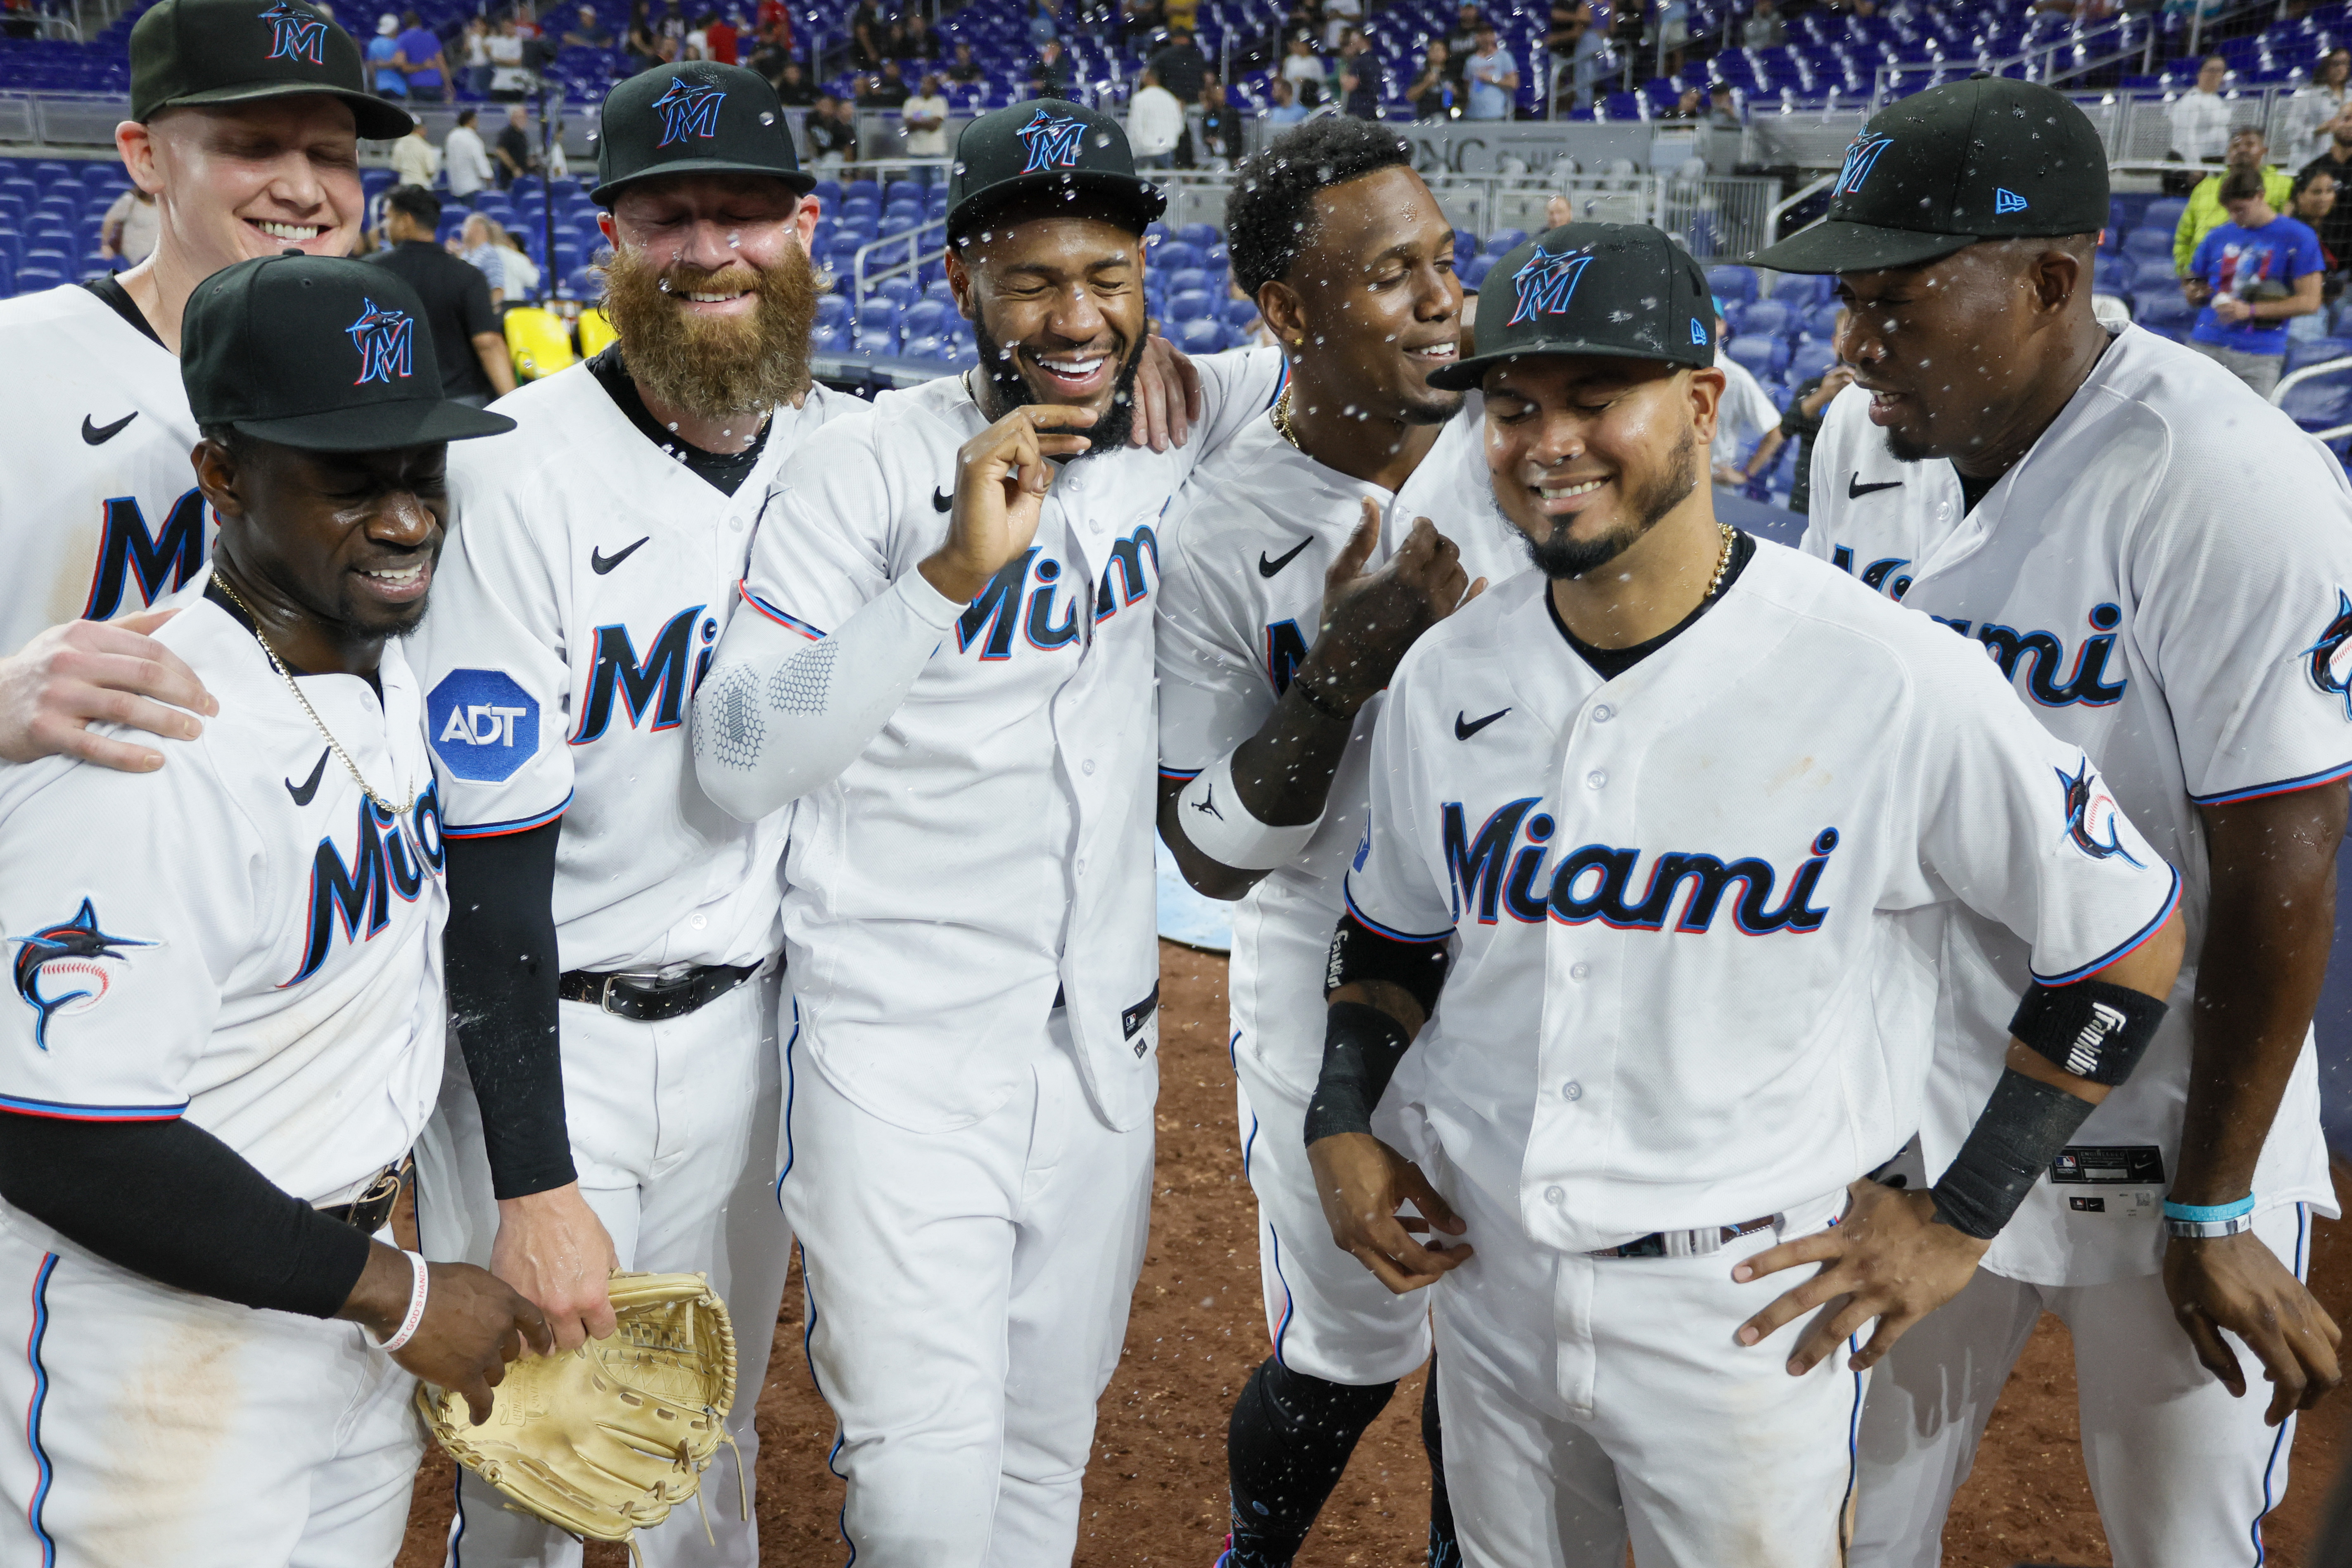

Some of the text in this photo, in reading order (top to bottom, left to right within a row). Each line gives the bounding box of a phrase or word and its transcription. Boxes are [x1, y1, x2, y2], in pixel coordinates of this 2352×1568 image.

[1413, 138, 1488, 175] NC
[439, 704, 527, 747] ADT
[1441, 797, 1839, 937] Miami
[1327, 930, 1349, 988] Franklin
[2065, 1002, 2126, 1075] Franklin
[406, 1300, 422, 1331] GOD'S
